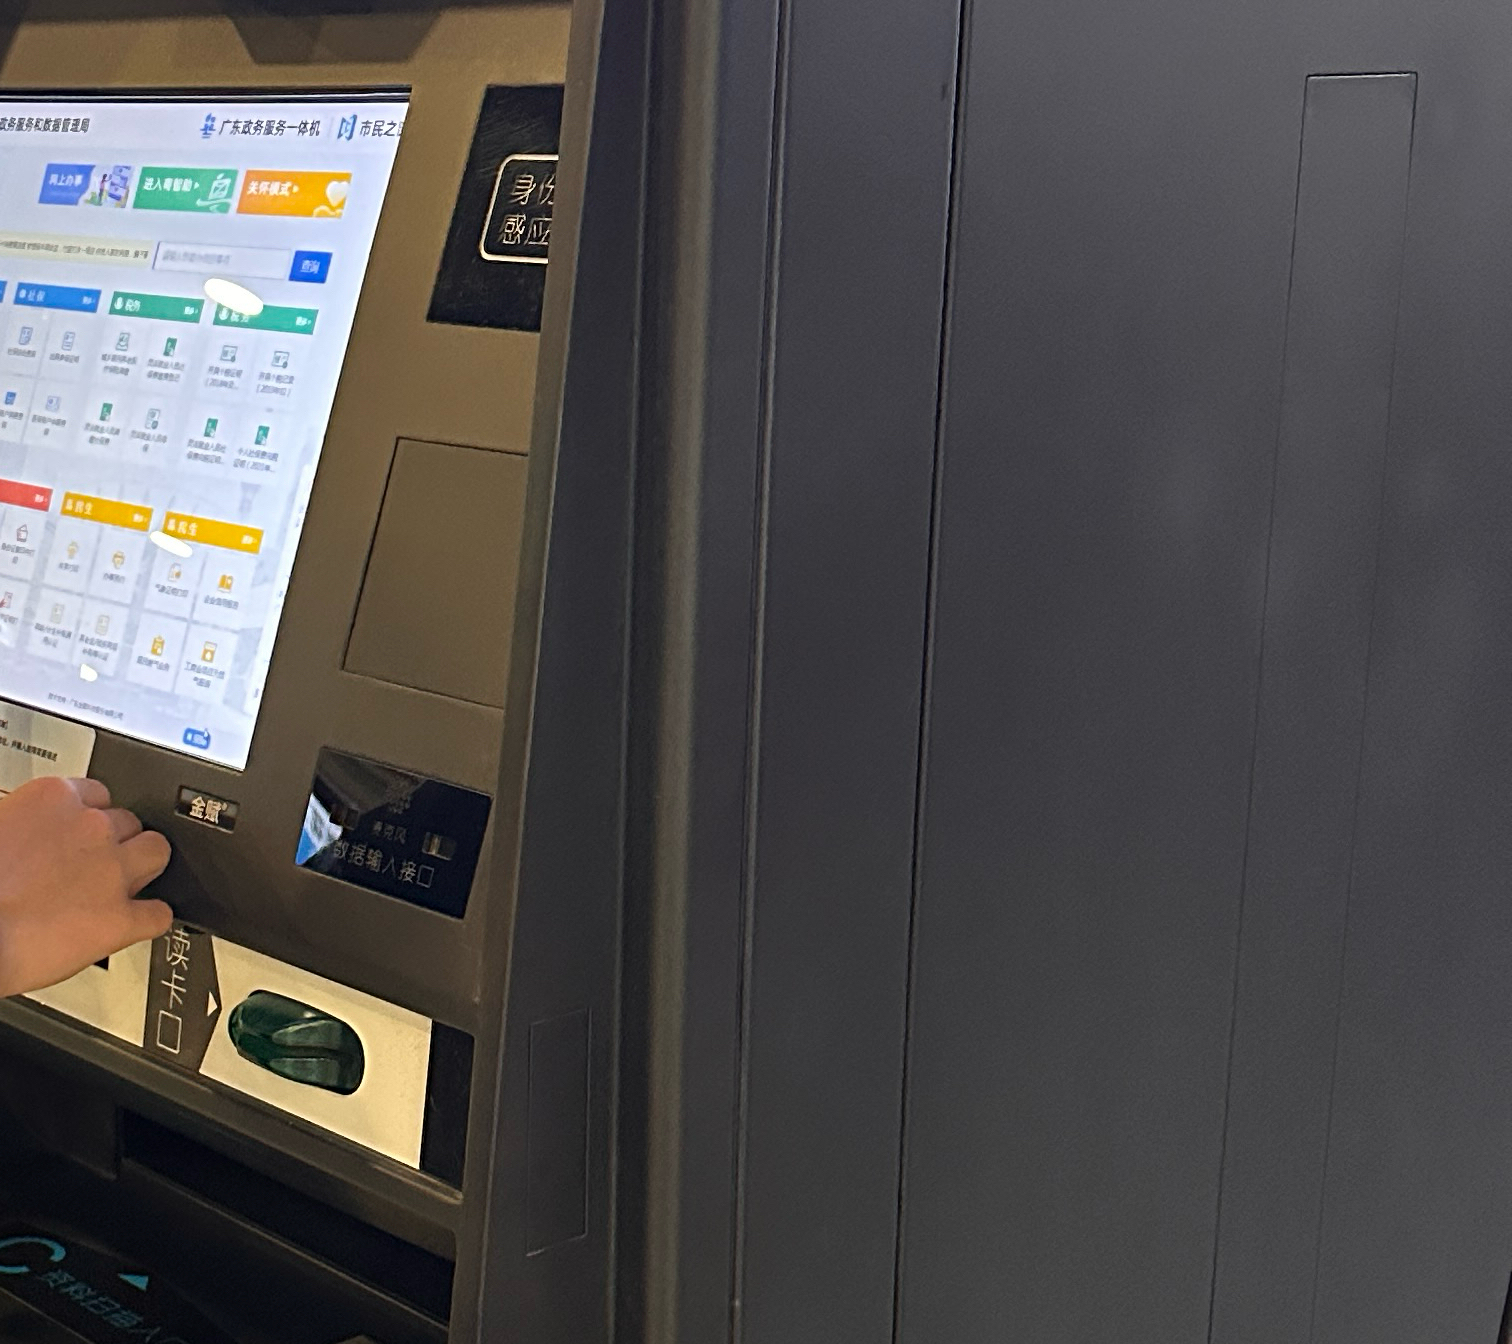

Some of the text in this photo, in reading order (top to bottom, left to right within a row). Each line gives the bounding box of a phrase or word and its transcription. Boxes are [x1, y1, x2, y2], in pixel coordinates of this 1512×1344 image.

[219, 119, 320, 137] 广东政务服务一体机
[247, 180, 291, 197] 关怀模式
[334, 839, 435, 889] 数据输入接口
[156, 928, 190, 1054] 读卡口
